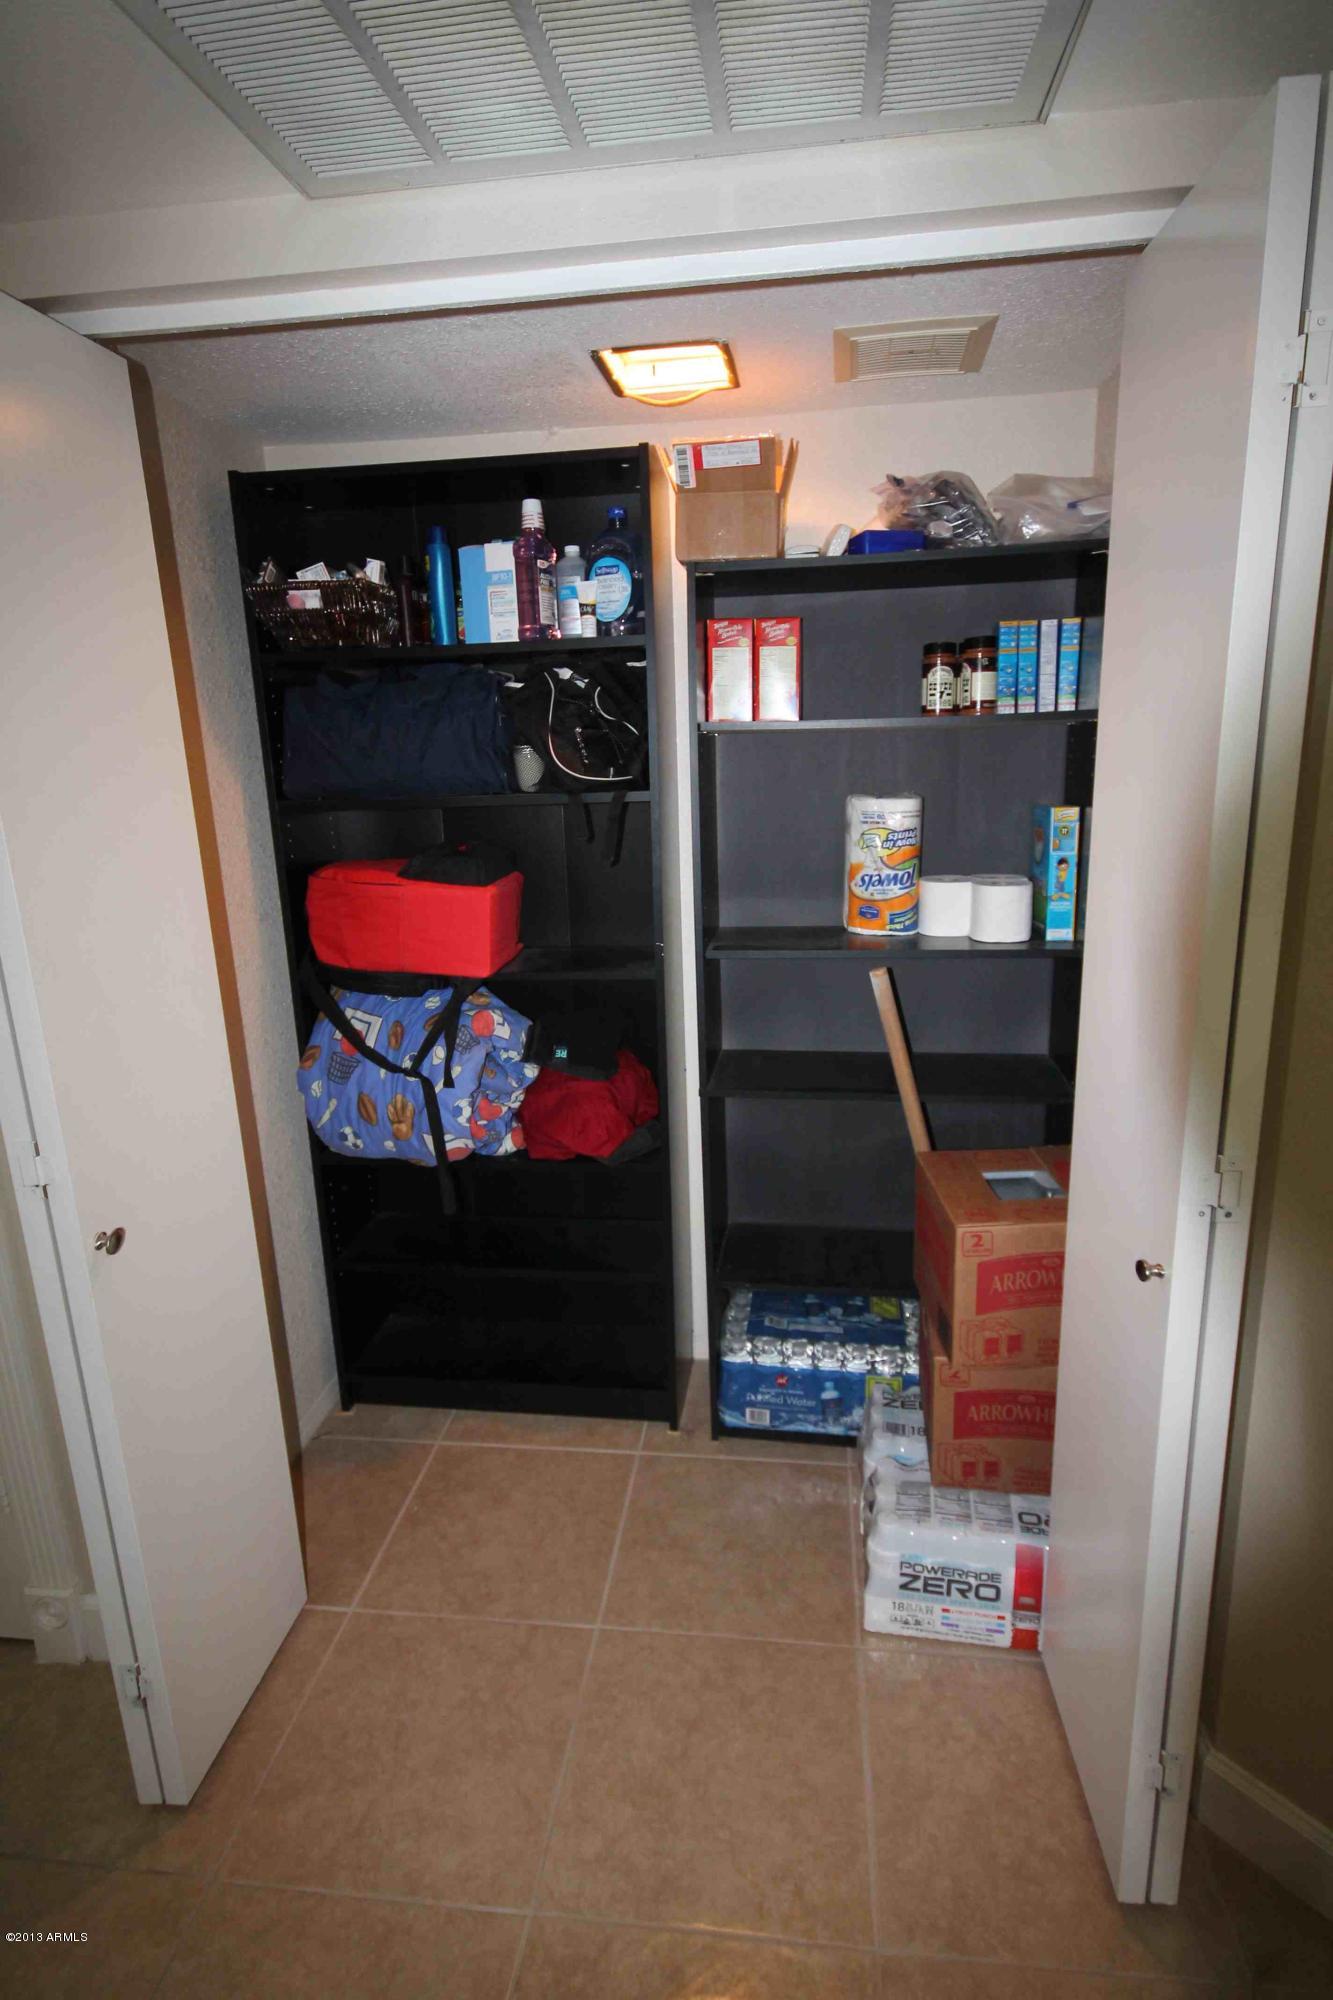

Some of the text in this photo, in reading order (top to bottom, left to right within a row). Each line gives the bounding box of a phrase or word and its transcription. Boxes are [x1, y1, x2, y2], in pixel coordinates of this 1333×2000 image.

[859, 863, 917, 891] Towels
[970, 1233, 985, 1249] 2
[990, 1268, 1059, 1296] ARROW
[967, 1404, 1054, 1424] ARROWH
[900, 1560, 1002, 1584] POWERADE
[899, 1573, 1002, 1603] ZERO
